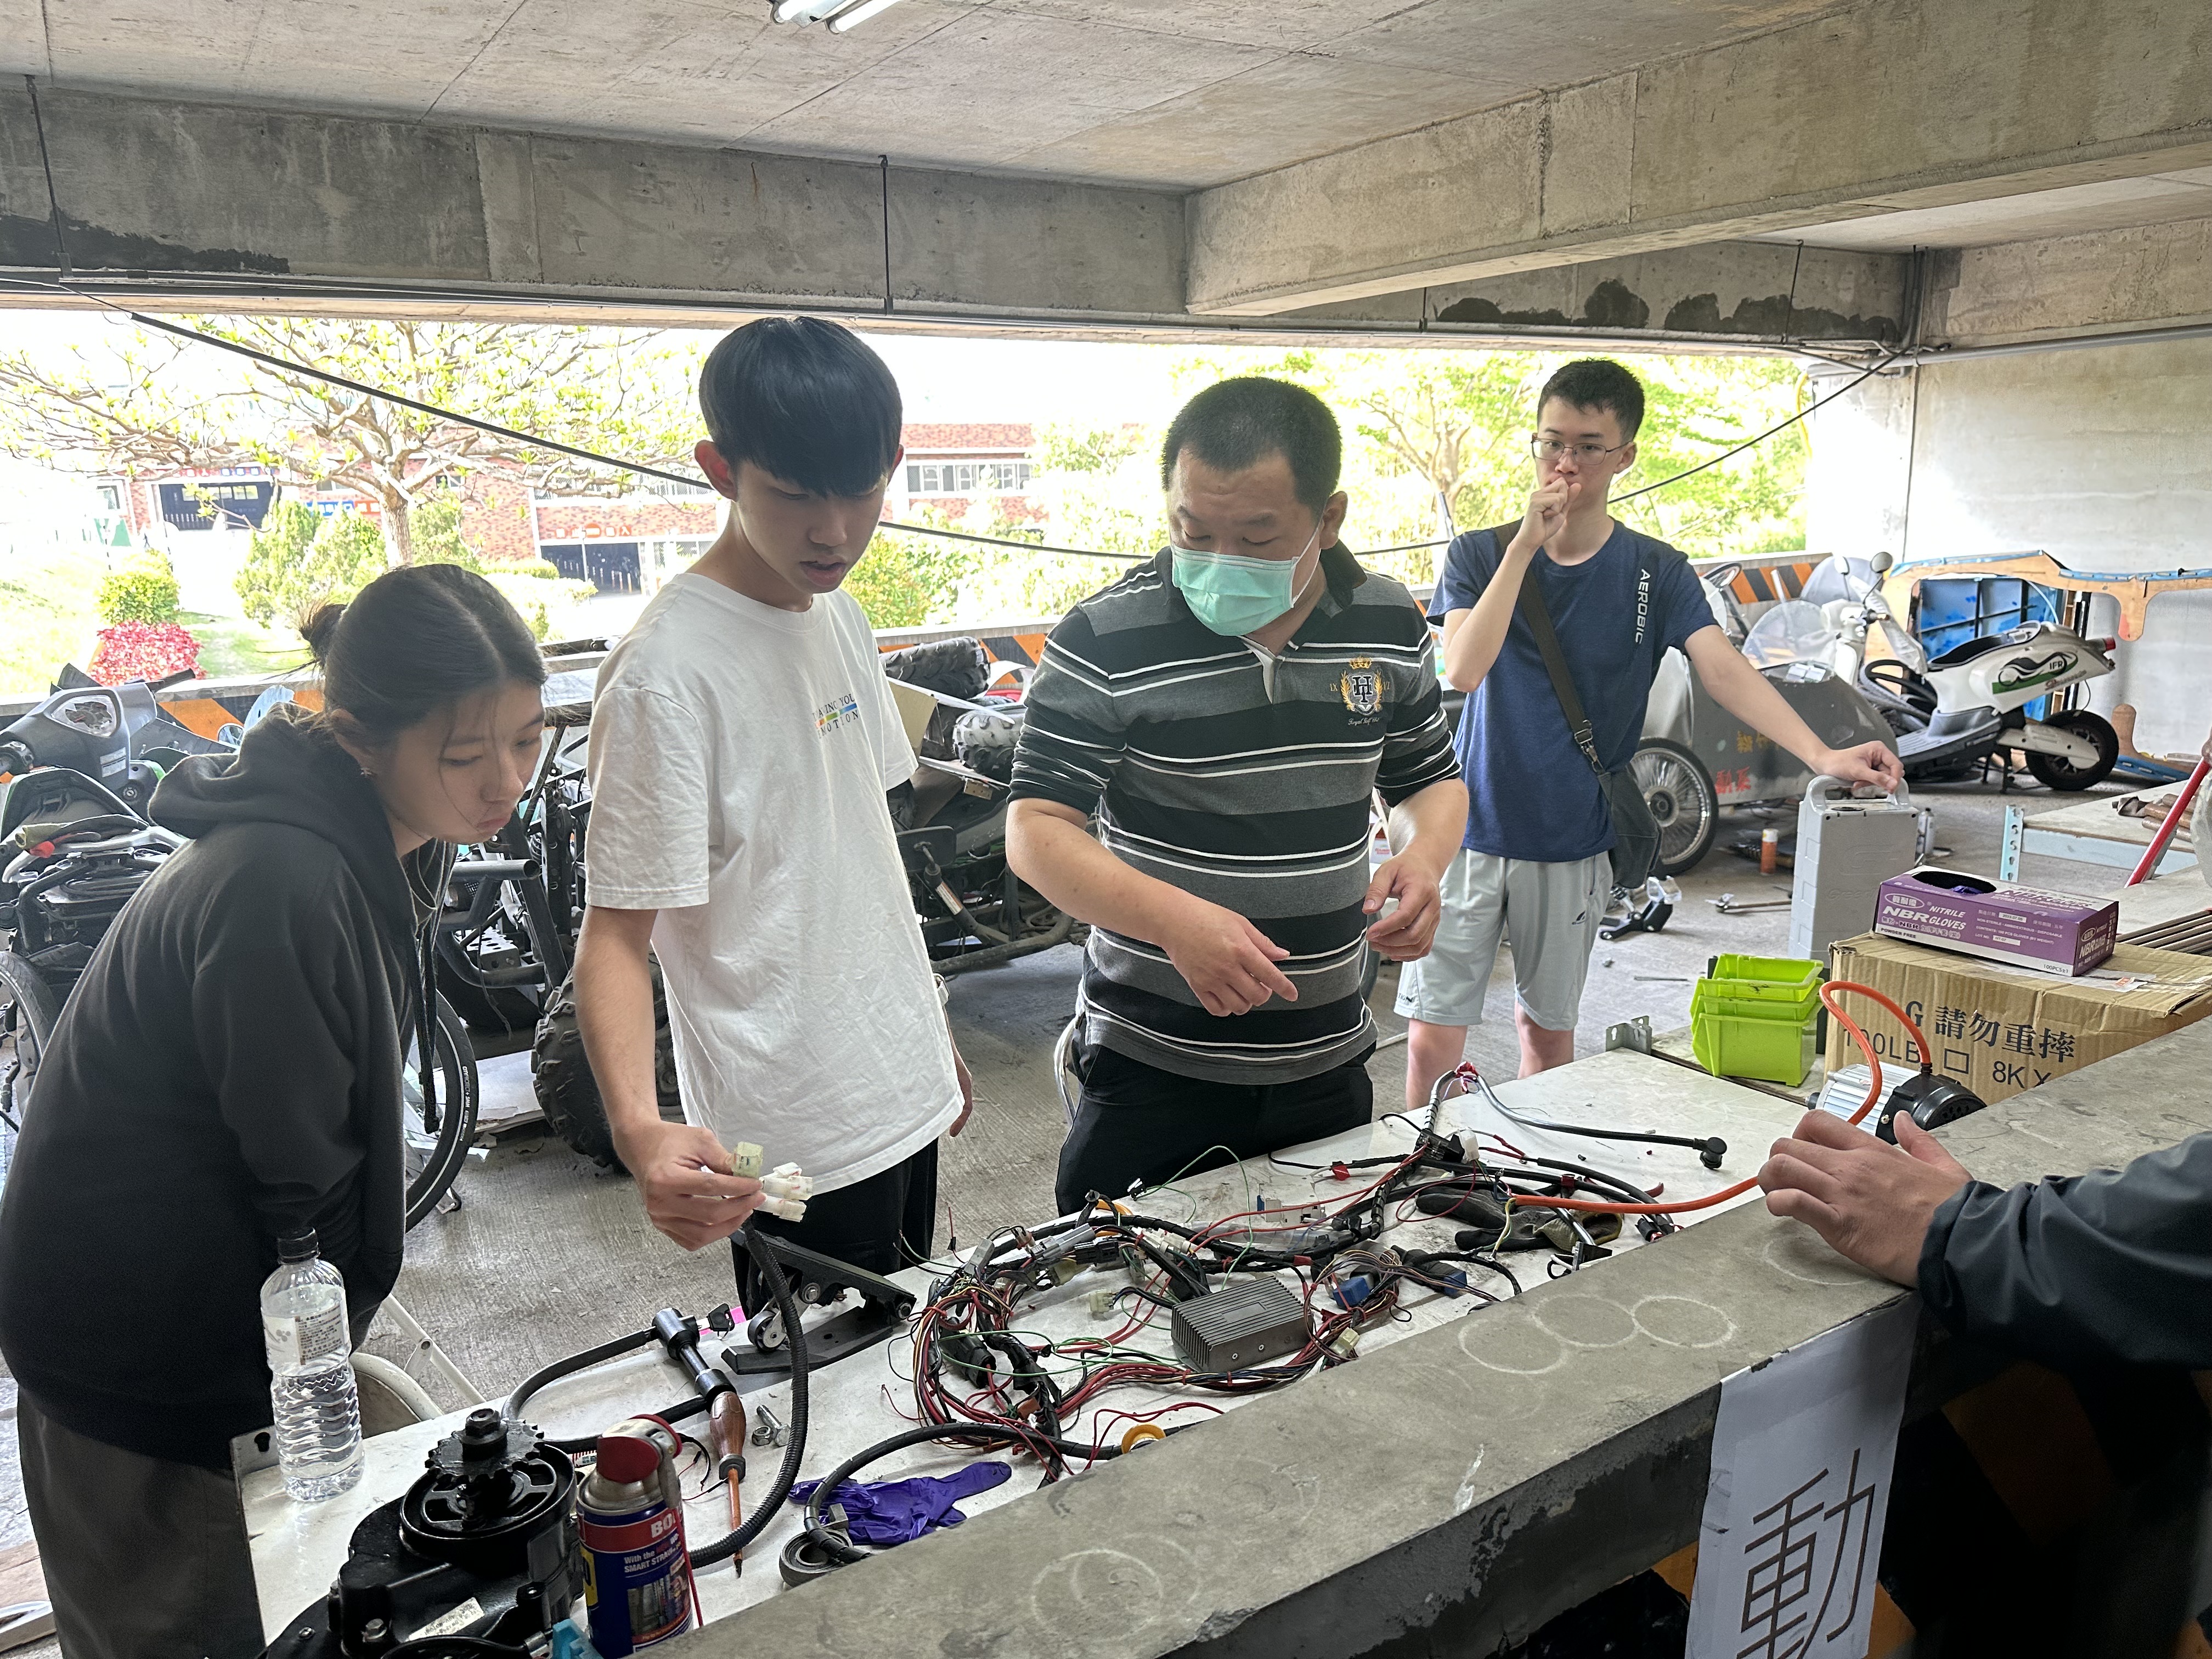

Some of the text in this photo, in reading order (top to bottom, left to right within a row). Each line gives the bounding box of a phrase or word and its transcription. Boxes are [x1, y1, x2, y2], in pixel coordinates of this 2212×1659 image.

[1635, 568, 1651, 645] AEROBIC
[2049, 661, 2063, 670] IFR
[1883, 906, 1966, 930] NBR GLOVES
[1929, 906, 1966, 918] NITRILE
[1881, 927, 1902, 936] POWDER
[1899, 921, 1919, 929] NBR
[1935, 1006, 2075, 1063] 請勿重摔
[651, 1513, 675, 1538] BO
[624, 1550, 655, 1564] With the
[1735, 1448, 1876, 1658] 動
[624, 1559, 651, 1573] SMART
